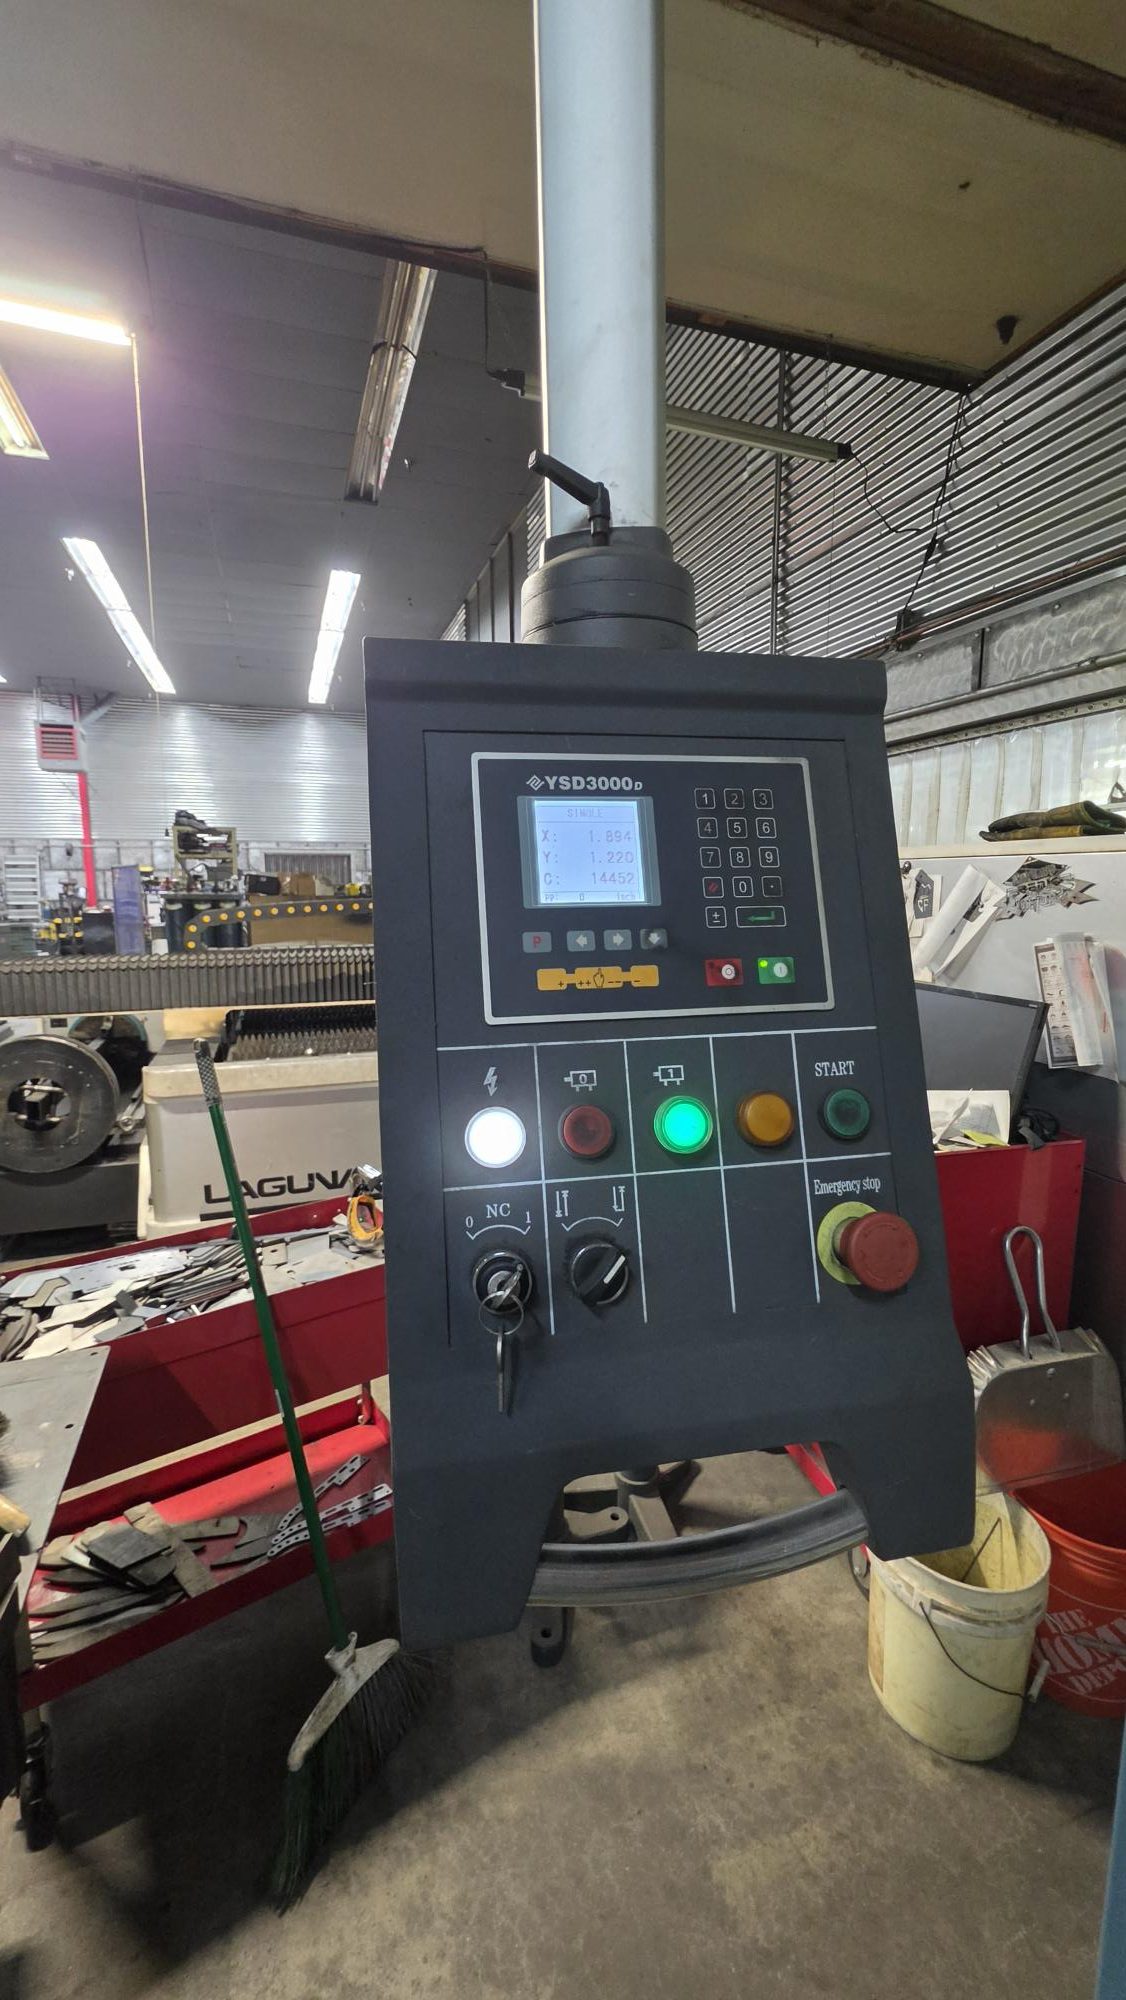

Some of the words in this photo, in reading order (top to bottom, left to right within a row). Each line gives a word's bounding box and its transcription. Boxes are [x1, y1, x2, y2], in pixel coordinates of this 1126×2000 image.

[702, 792, 708, 805] 1
[731, 793, 739, 805] 2
[759, 793, 768, 805] 3
[704, 822, 712, 833] 4
[733, 822, 741, 834] 5
[762, 822, 770, 834] 6
[588, 829, 633, 843] 1.894
[590, 851, 635, 864] 1.220
[706, 851, 714, 863] 7
[736, 851, 744, 863] 8
[765, 851, 773, 863] 9
[591, 871, 635, 885] 14452
[738, 880, 747, 893] 0
[532, 936, 541, 947] P
[814, 1060, 855, 1077] START
[813, 1179, 861, 1197] Emergency
[862, 1176, 881, 1193] stop
[485, 1203, 511, 1219] NC
[465, 1215, 474, 1228] 0
[525, 1211, 532, 1224] 1
